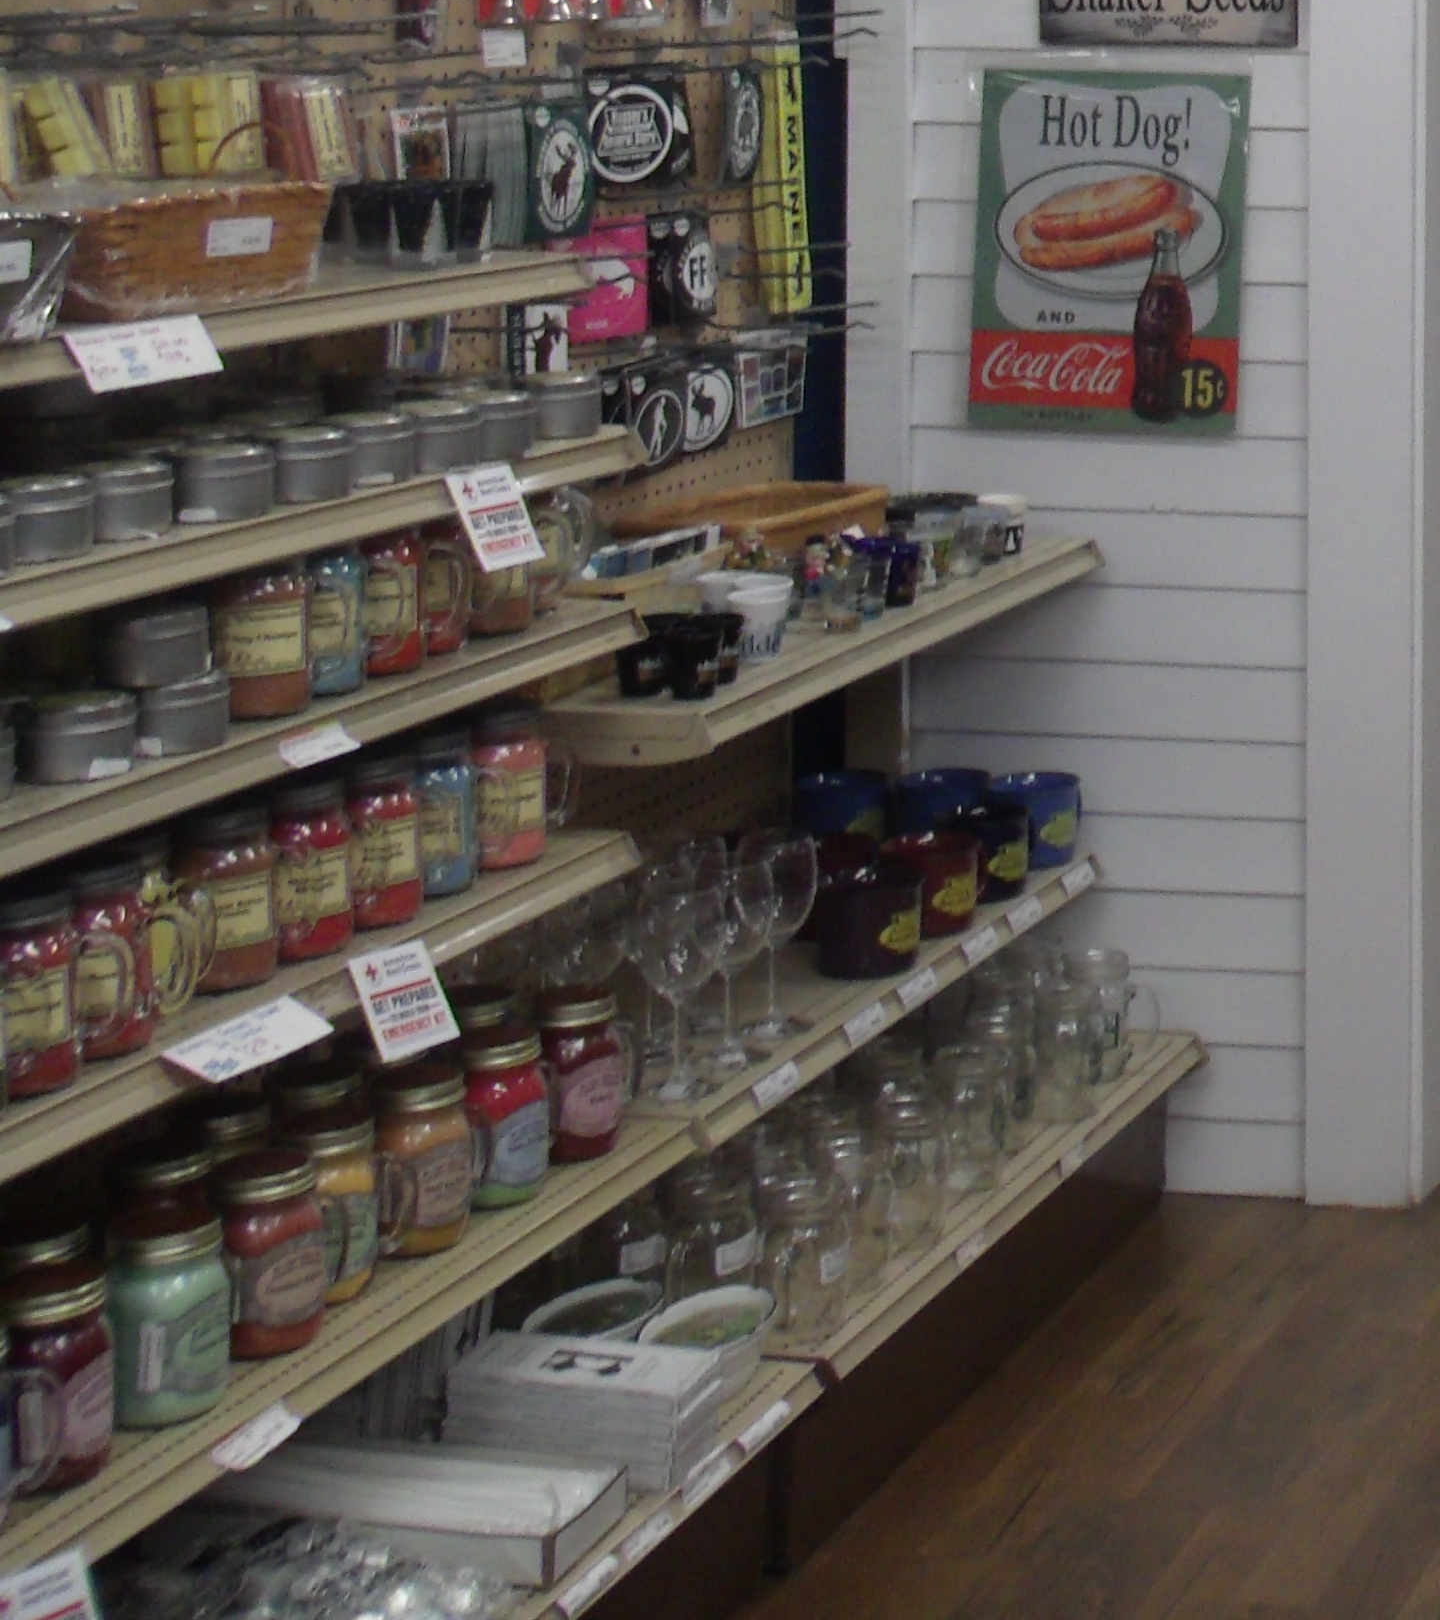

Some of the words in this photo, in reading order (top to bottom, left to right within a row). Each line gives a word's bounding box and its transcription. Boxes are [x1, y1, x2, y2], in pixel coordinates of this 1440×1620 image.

[1040, 94, 1102, 147] Hot
[1113, 94, 1192, 167] Dog!
[1036, 311, 1076, 324] AND
